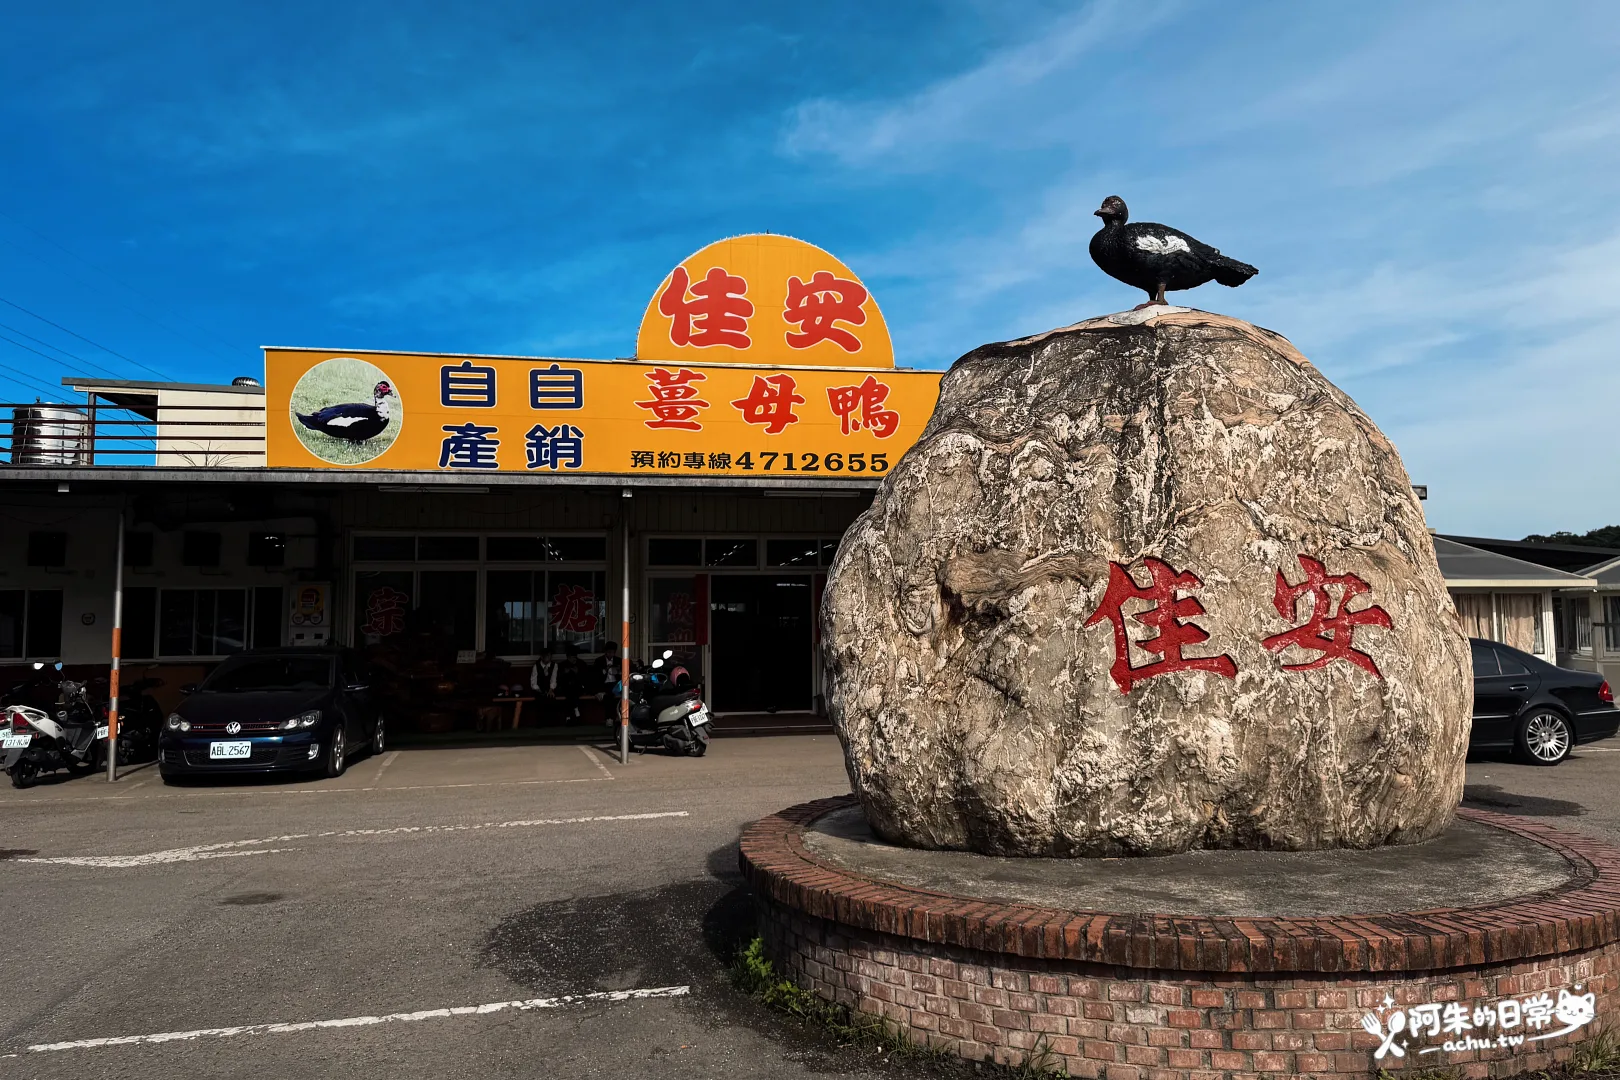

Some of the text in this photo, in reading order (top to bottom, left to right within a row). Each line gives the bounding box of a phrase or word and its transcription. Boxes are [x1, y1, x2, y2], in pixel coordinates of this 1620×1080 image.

[658, 265, 869, 353] 佳安
[634, 367, 901, 438] 薑母鴨
[1083, 553, 1395, 696] 佳安
